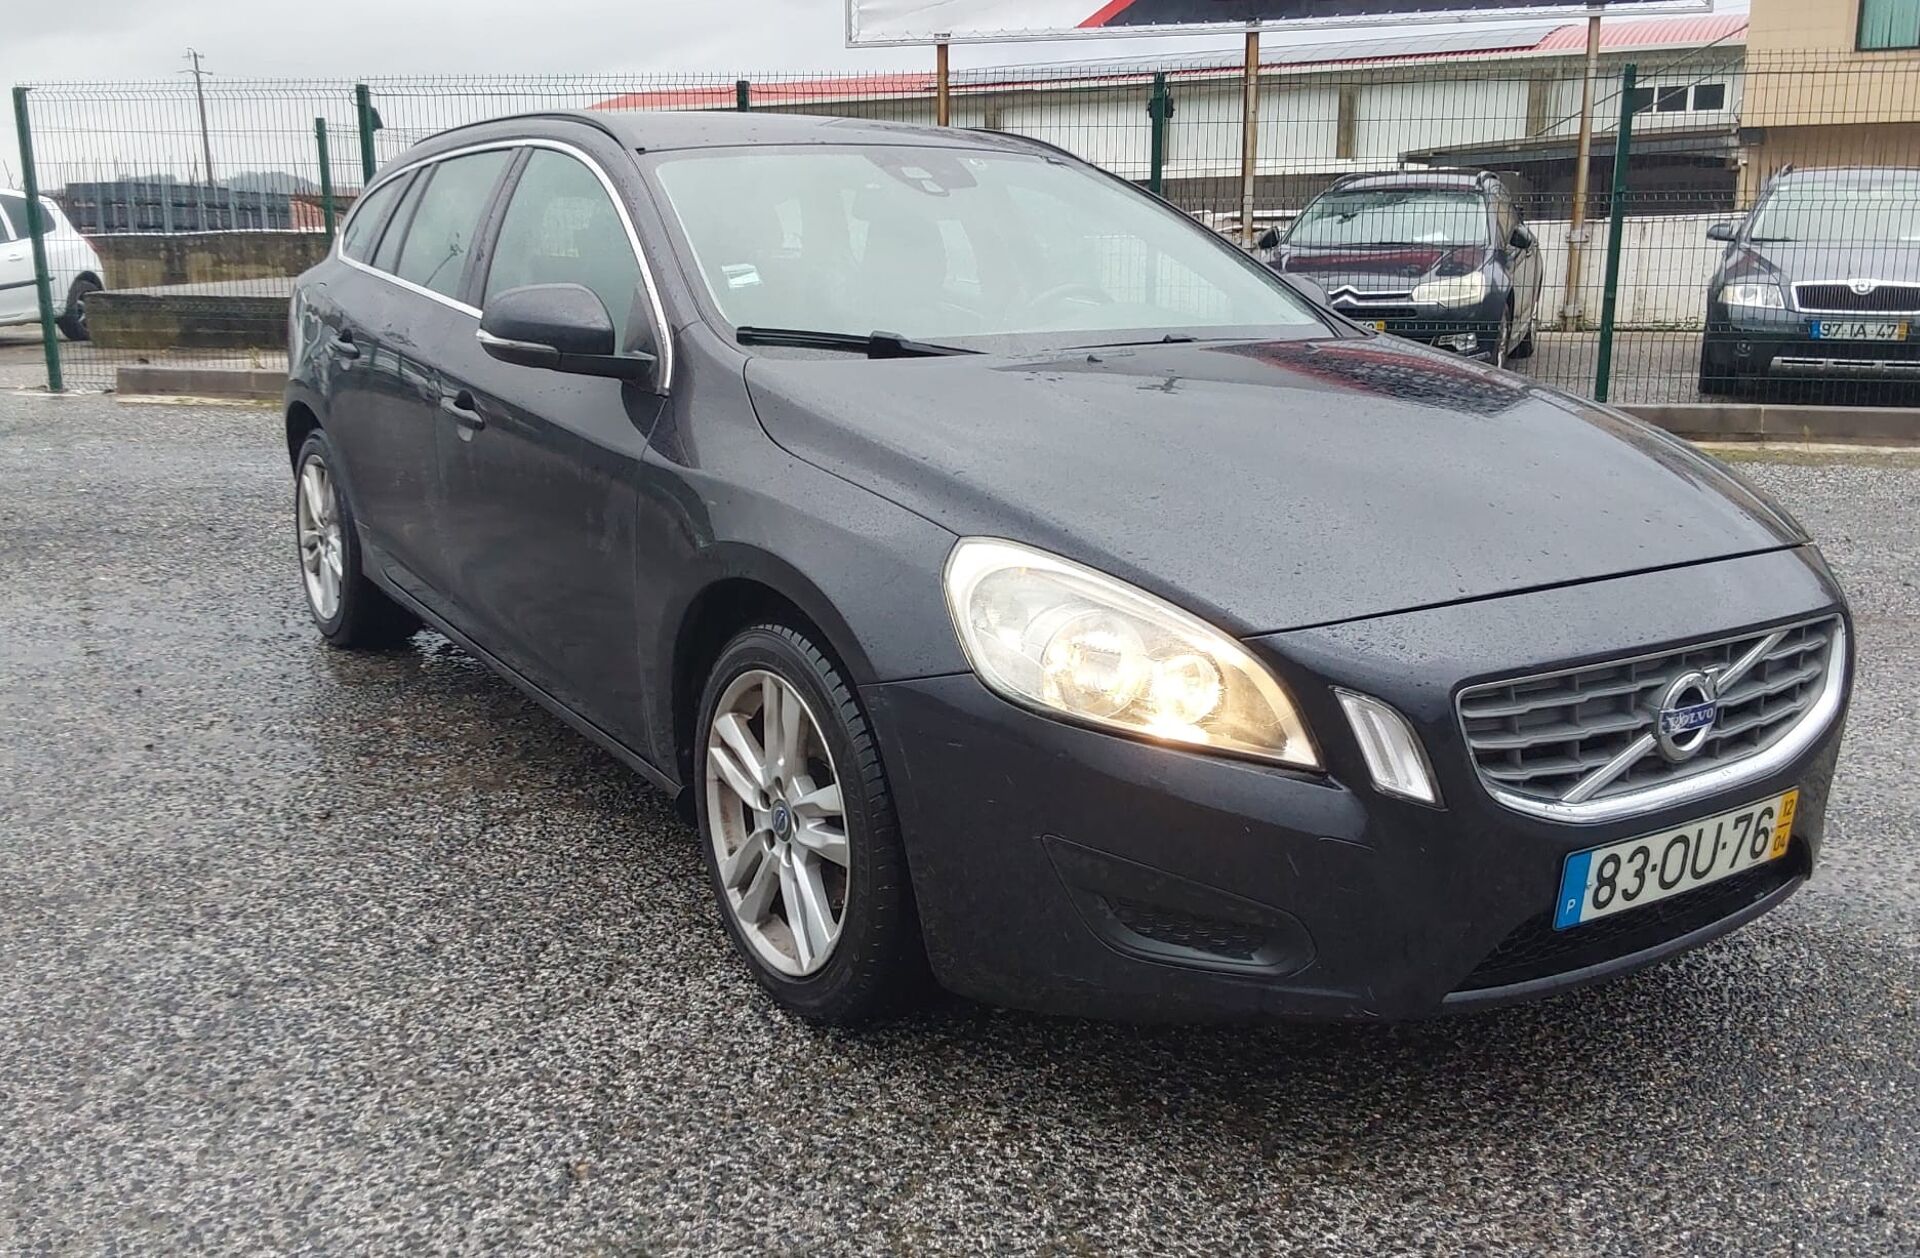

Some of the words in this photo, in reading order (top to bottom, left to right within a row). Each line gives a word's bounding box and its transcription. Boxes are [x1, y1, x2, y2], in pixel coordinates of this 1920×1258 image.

[1666, 707, 1713, 728] VOLVO
[1783, 799, 1794, 817] 12
[1773, 832, 1787, 851] 04
[1566, 898, 1576, 915] P
